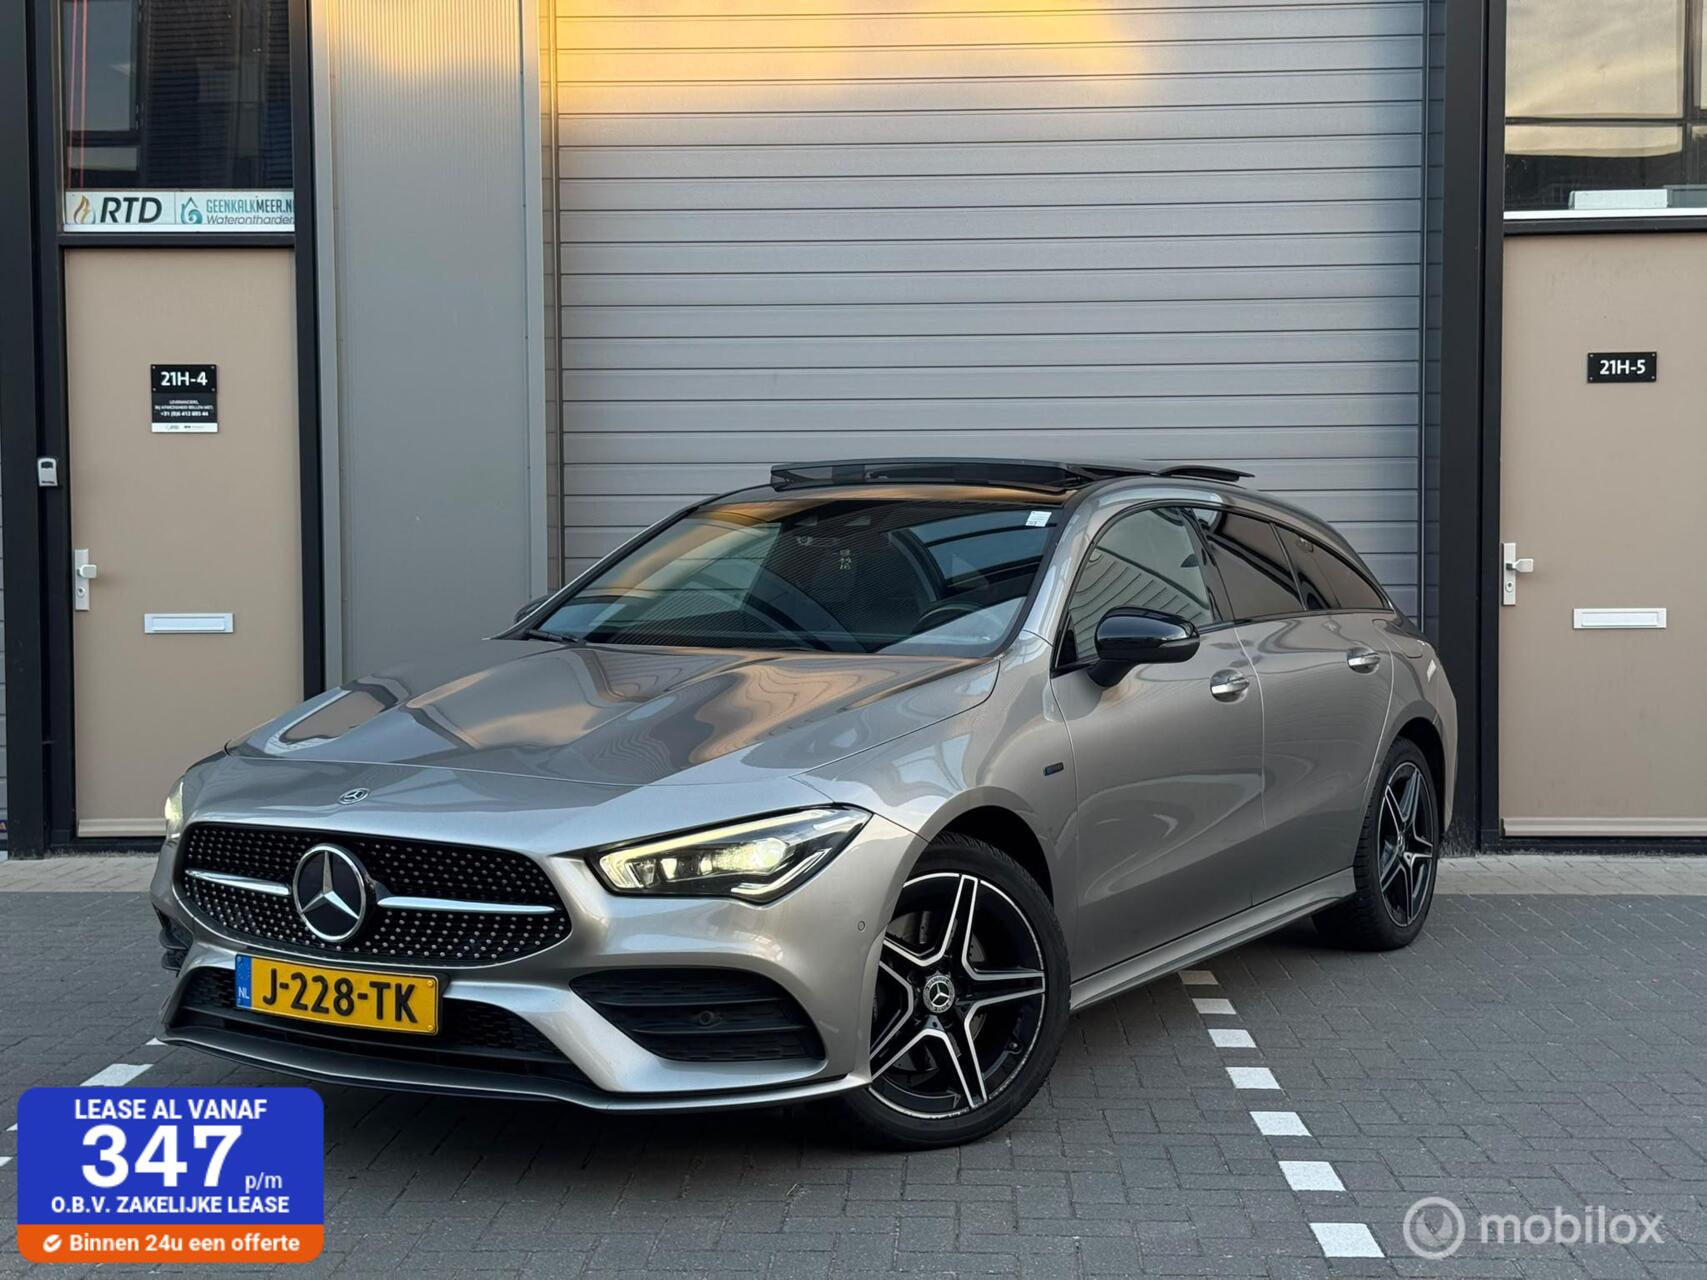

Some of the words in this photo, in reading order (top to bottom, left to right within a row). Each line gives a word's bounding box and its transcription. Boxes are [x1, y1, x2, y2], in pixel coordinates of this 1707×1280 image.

[101, 197, 162, 223] RTD
[1600, 359, 1646, 375] 21H-5
[161, 371, 208, 386] 21H-4
[238, 986, 250, 999] NL
[262, 967, 418, 1023] J-228-TK
